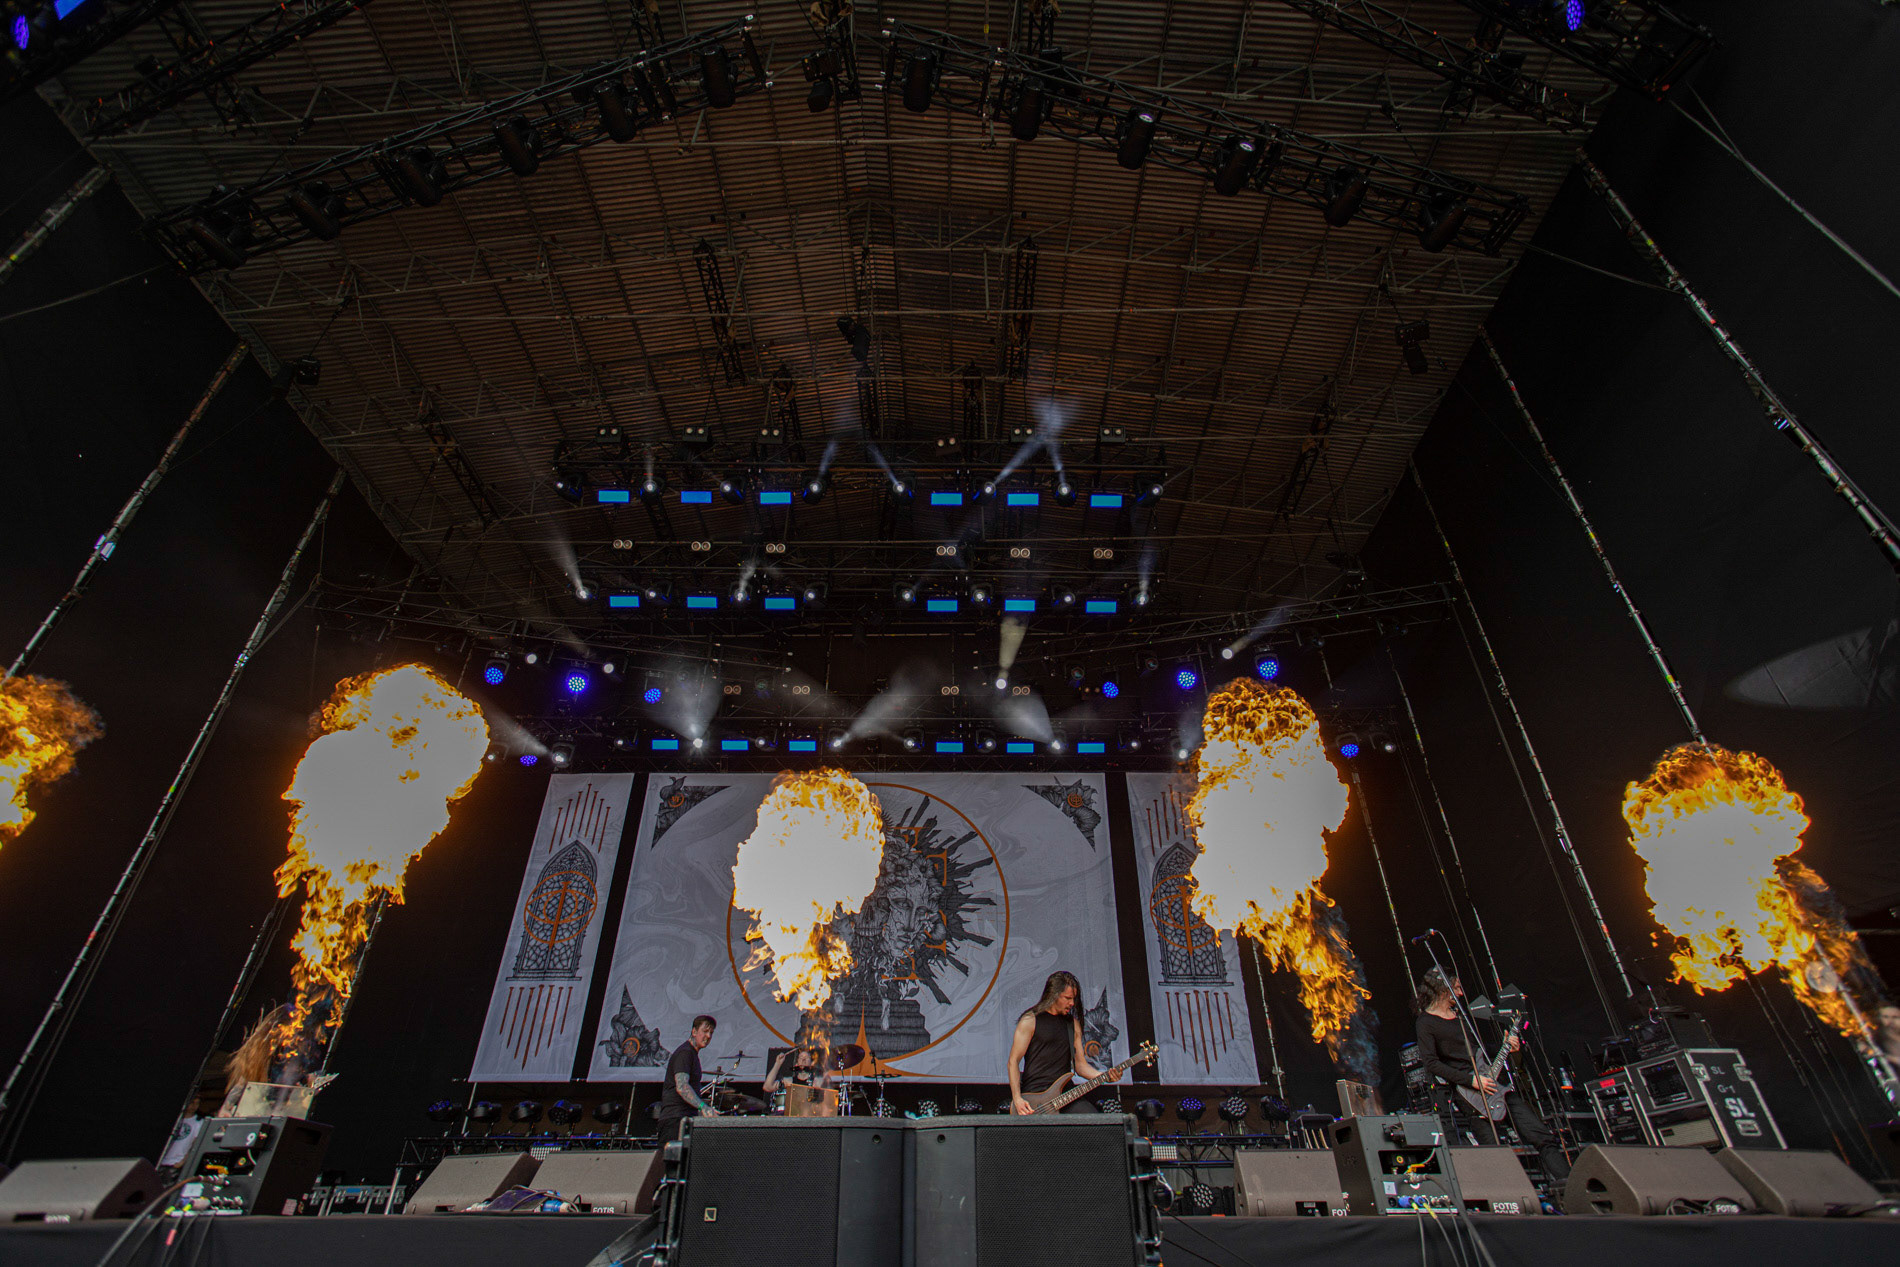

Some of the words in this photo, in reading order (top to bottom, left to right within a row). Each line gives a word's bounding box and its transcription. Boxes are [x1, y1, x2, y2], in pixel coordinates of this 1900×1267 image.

[1710, 1066, 1725, 1075] SL
[1724, 1097, 1756, 1118] SL
[246, 1132, 257, 1146] 9
[1492, 1202, 1519, 1210] FOTIS
[1331, 1208, 1348, 1217] FOT
